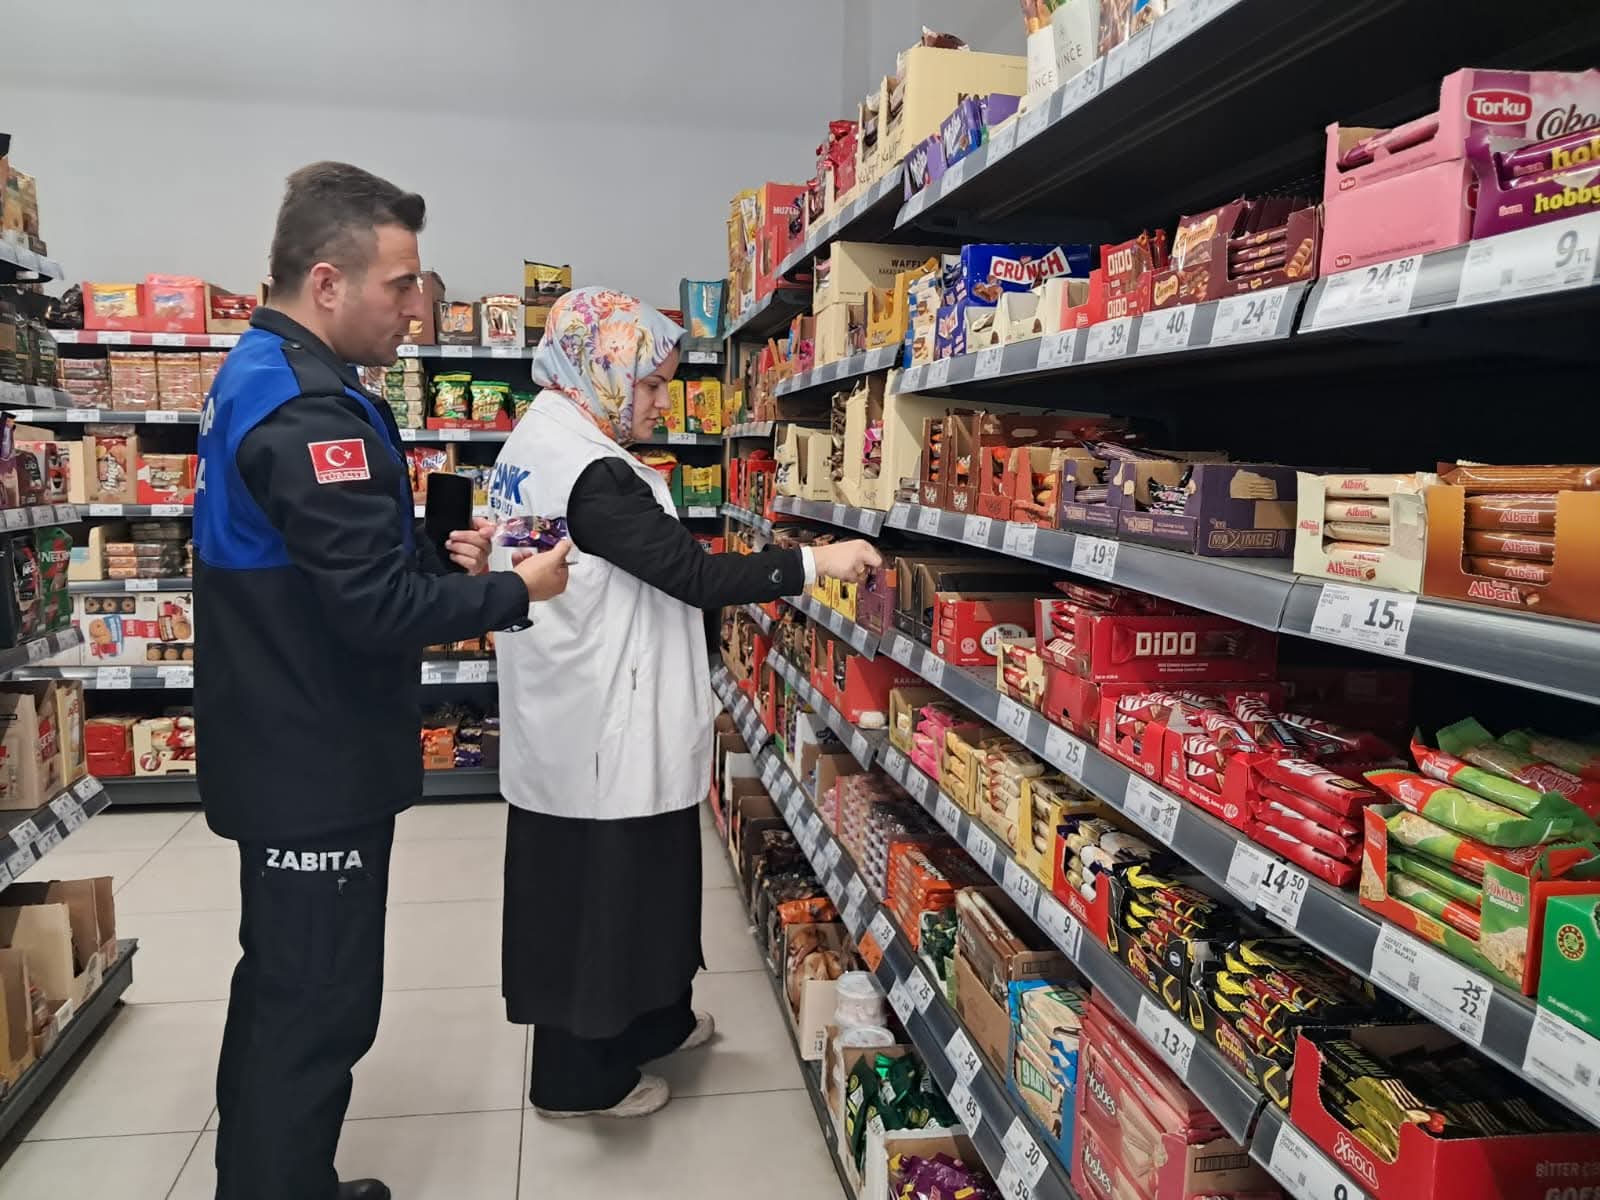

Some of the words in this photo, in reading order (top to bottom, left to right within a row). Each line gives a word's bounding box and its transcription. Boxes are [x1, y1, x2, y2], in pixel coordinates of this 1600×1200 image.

[1473, 97, 1526, 116] Torku
[1555, 230, 1579, 268] 9
[1576, 247, 1592, 264] TL
[993, 251, 1065, 281] CRUNCH
[1166, 310, 1185, 334] 40
[1108, 324, 1124, 345] 39
[1500, 511, 1539, 523] Albeni
[1212, 530, 1274, 550] MAXIMUS
[1501, 541, 1541, 554] Albeni
[1327, 562, 1364, 577] Albeni
[1504, 567, 1544, 581] Albeni
[1468, 581, 1521, 603] Albeni
[1364, 598, 1398, 629] 15
[1394, 619, 1405, 632] TL
[1014, 708, 1025, 727] 27
[1067, 741, 1080, 764] 25
[977, 839, 988, 857] 13
[266, 848, 363, 872] ZABITA
[1064, 915, 1072, 933] 9
[920, 983, 931, 1001] 25
[1460, 996, 1478, 1018] 22
[965, 1052, 977, 1071] 54
[1025, 1142, 1040, 1166] 30
[1336, 1133, 1377, 1184] XROLL
